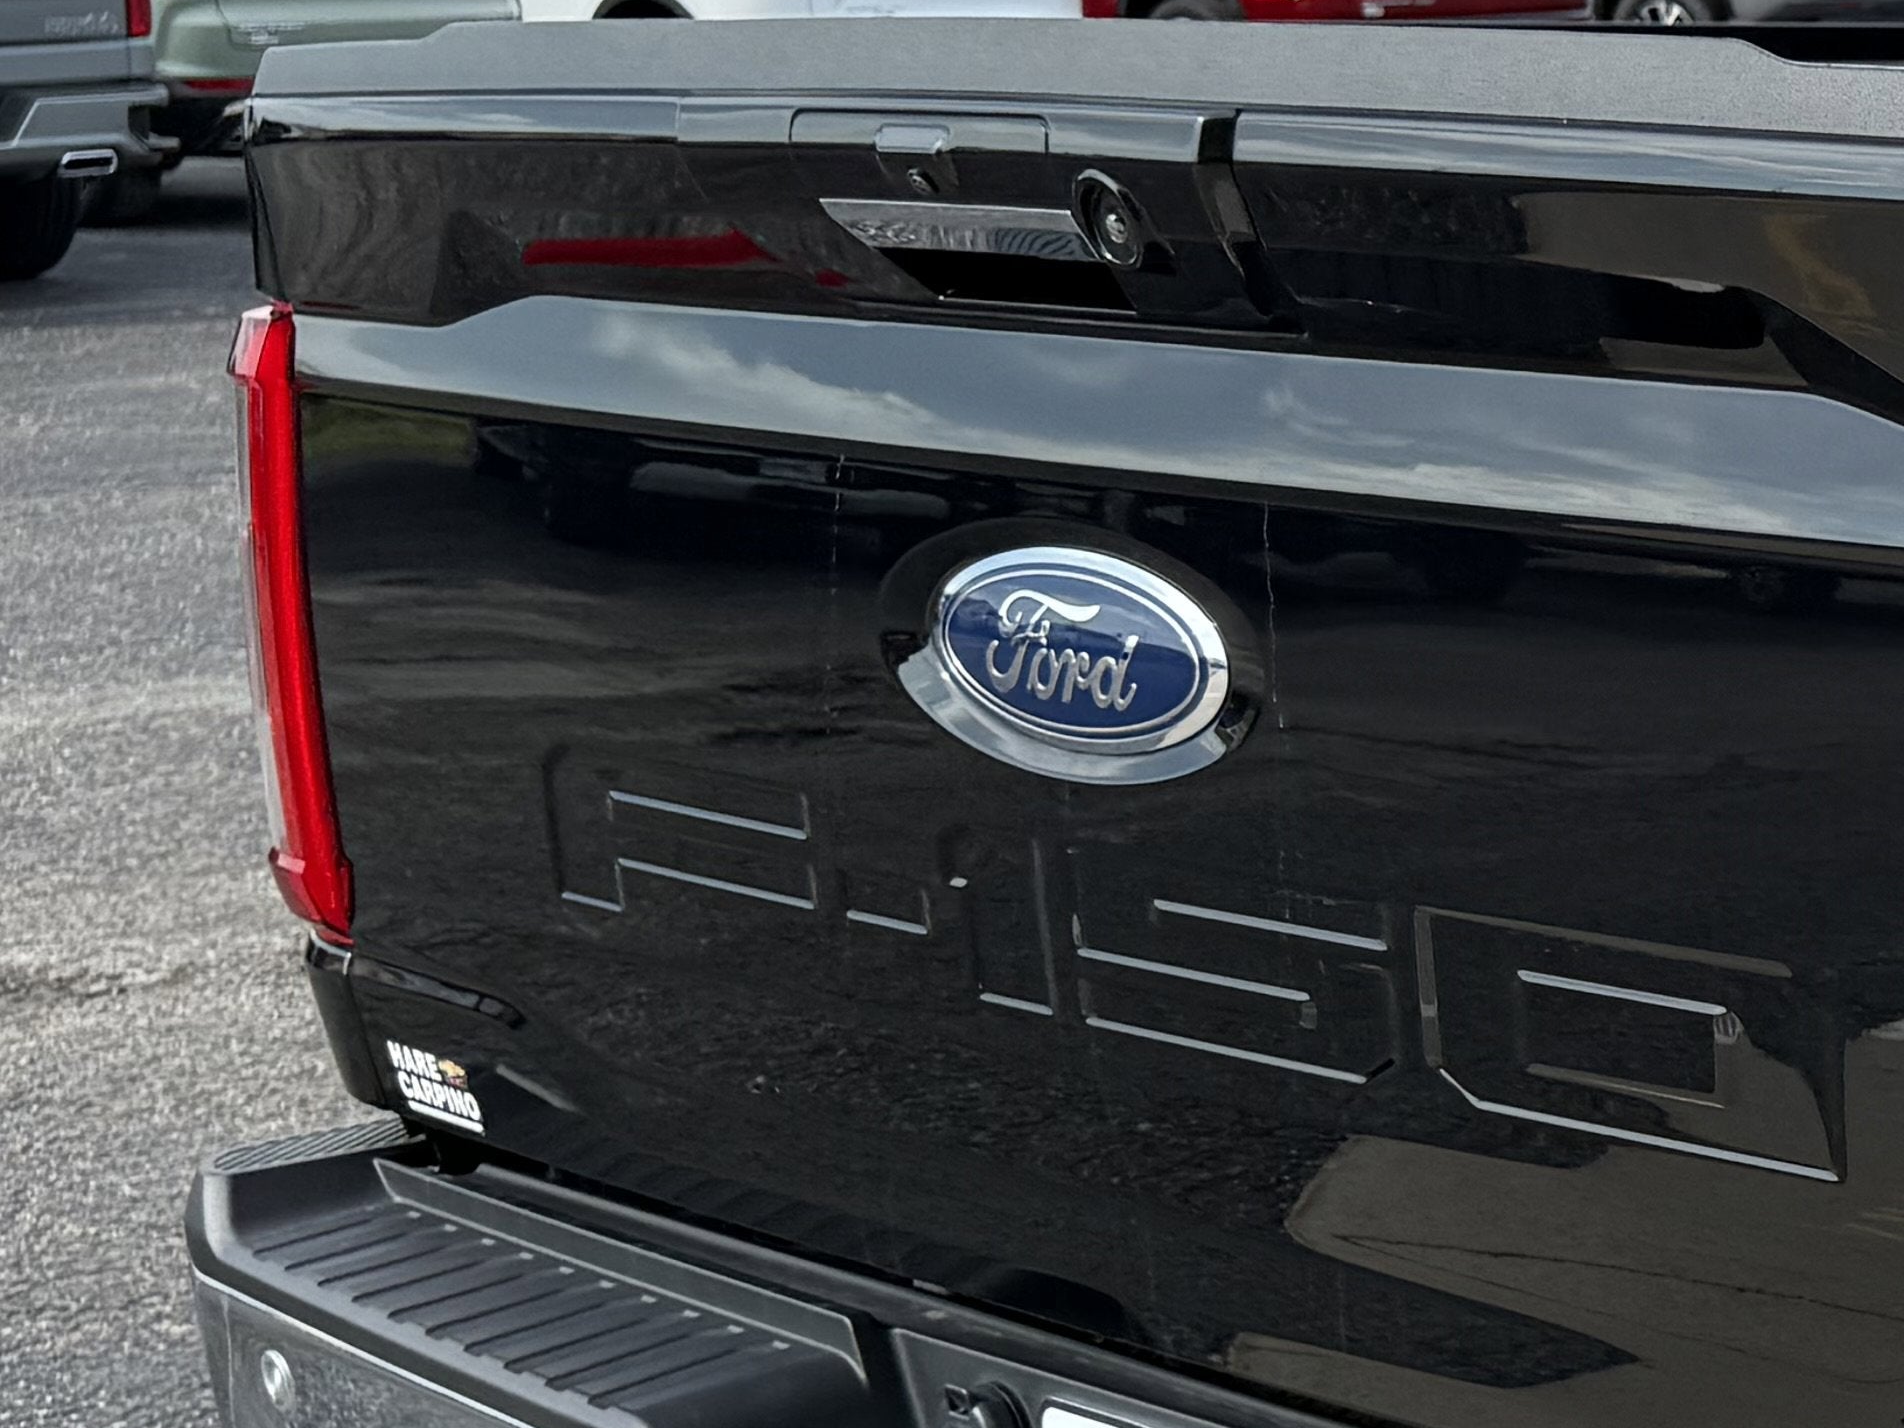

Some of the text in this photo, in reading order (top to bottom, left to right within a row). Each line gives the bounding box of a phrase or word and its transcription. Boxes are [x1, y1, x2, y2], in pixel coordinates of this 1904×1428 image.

[985, 588, 1140, 712] Ford
[386, 1039, 443, 1081] HARE
[397, 1070, 483, 1121] CARPINO
